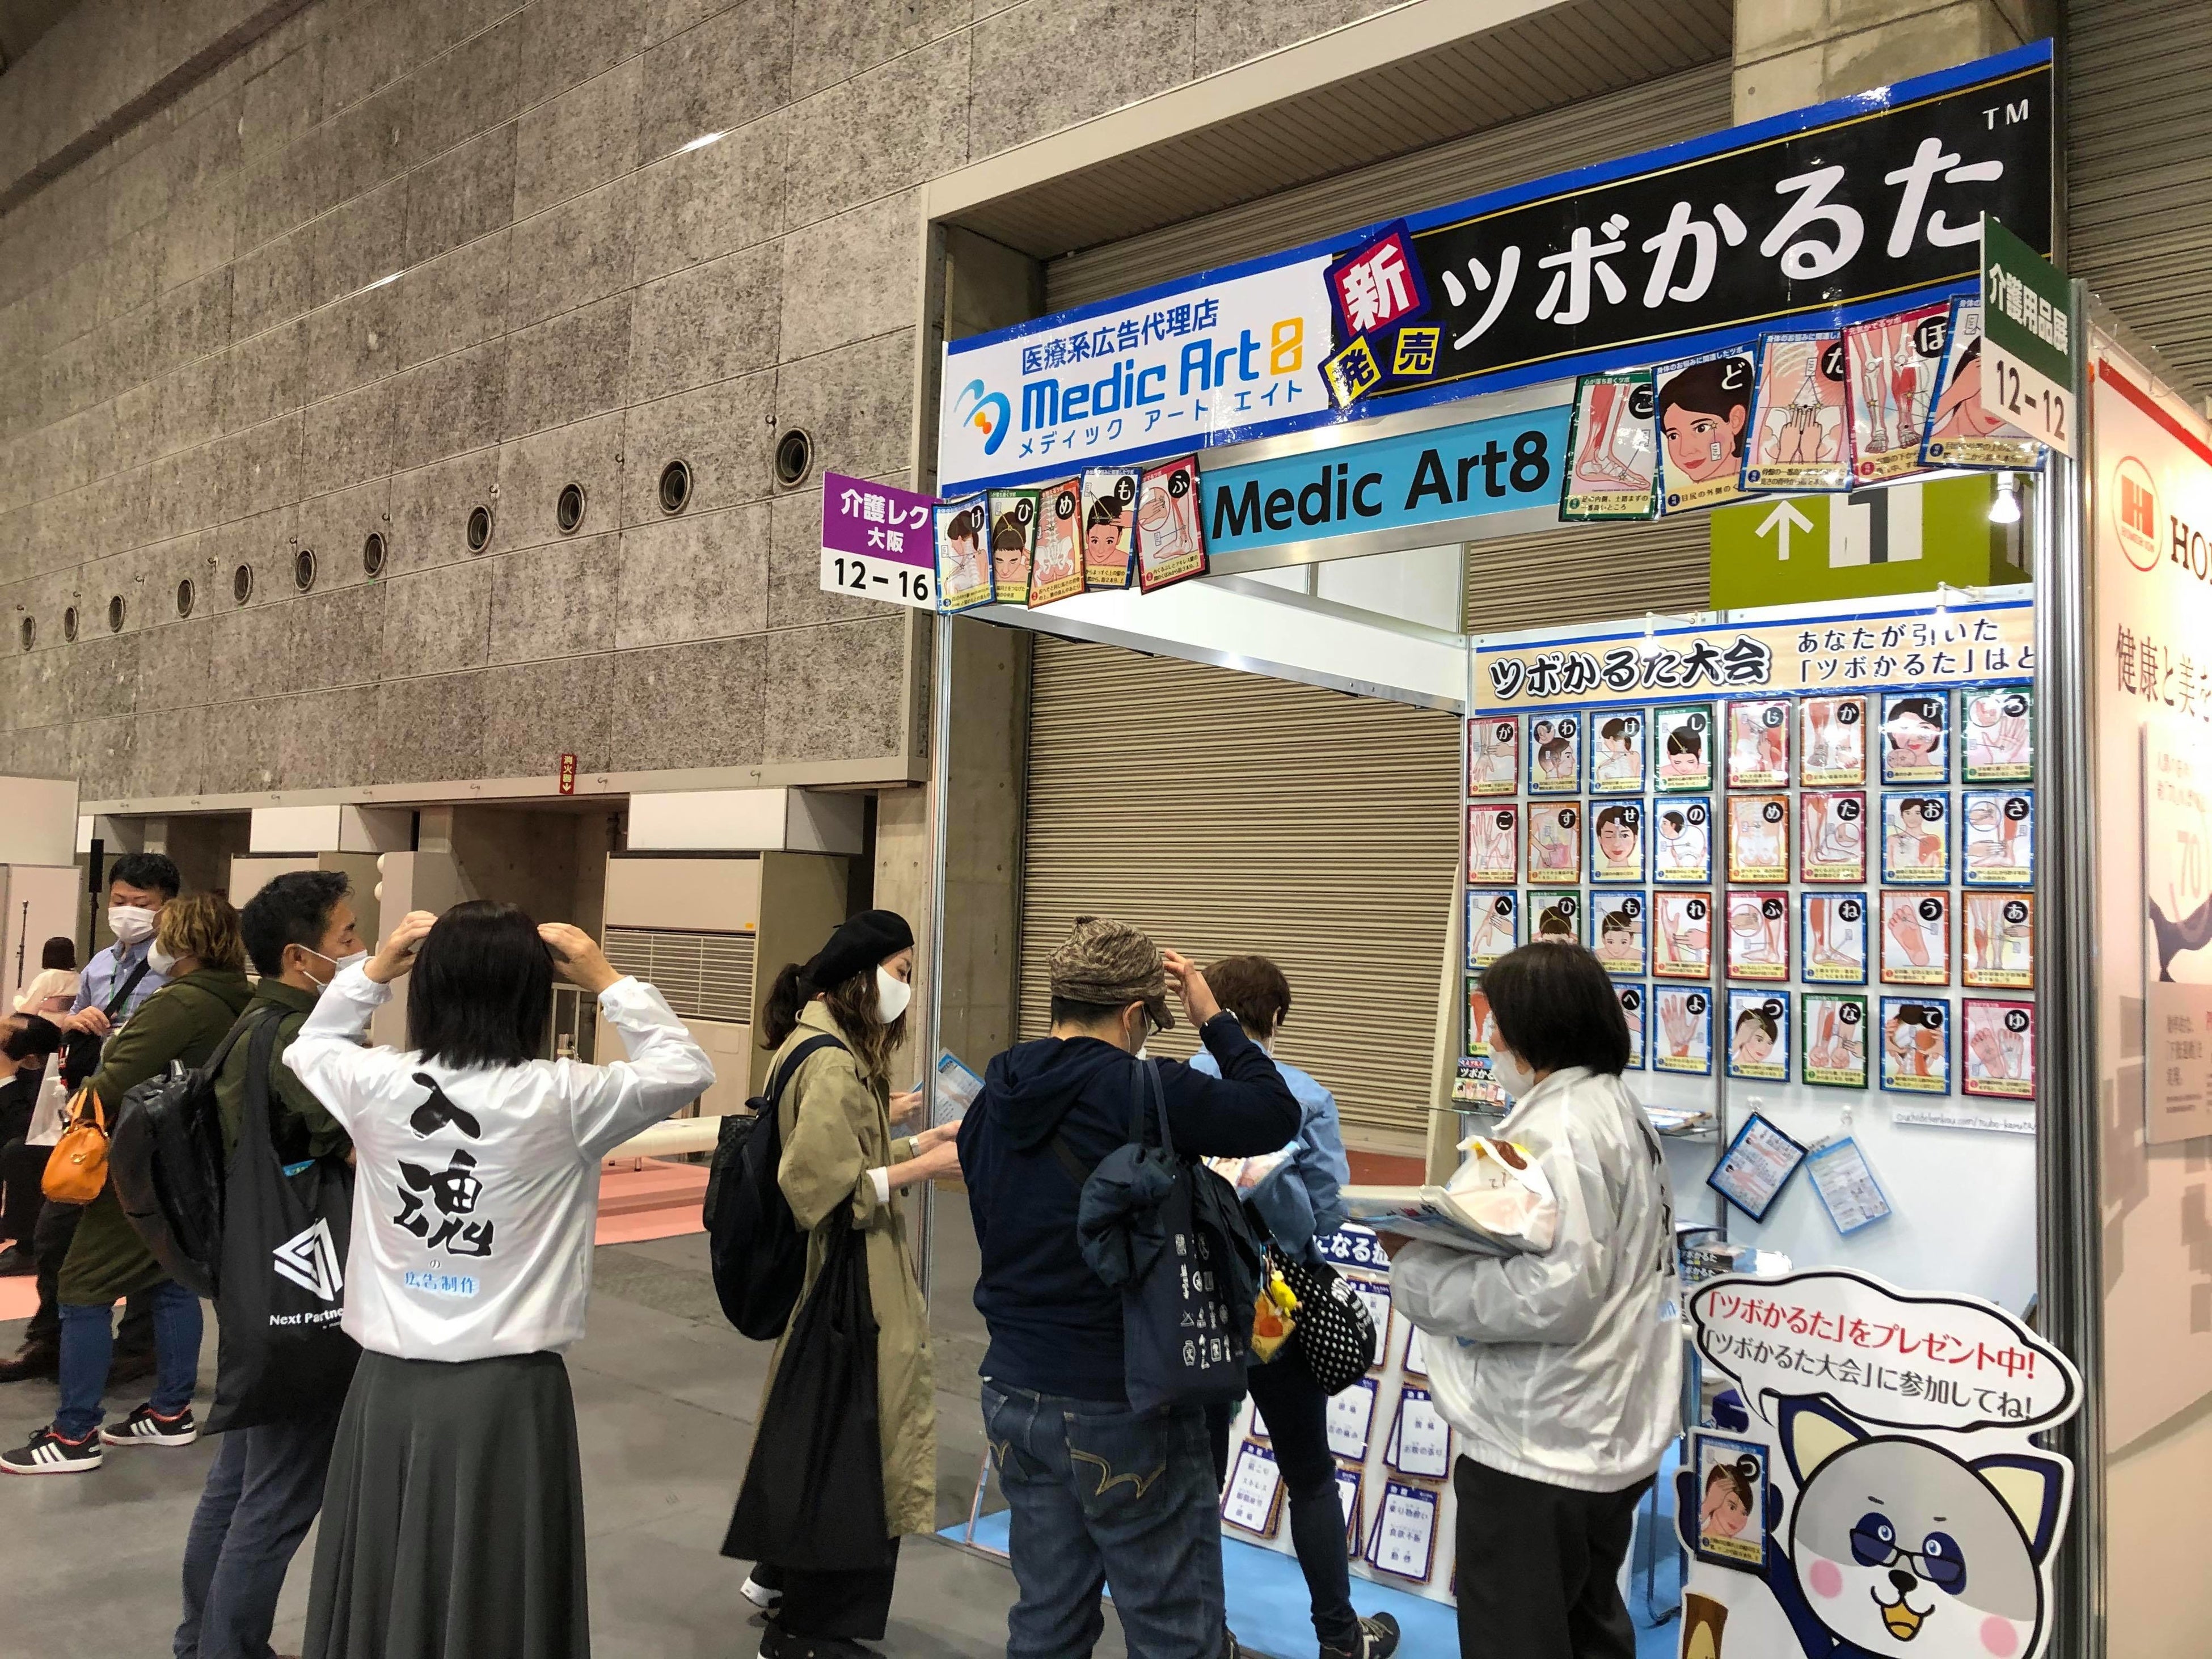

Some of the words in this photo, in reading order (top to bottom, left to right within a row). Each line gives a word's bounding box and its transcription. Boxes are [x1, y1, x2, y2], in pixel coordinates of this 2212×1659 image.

[1983, 98, 2029, 131] TM
[1442, 136, 2004, 351] ツボかるた
[1343, 244, 1409, 331] 新
[1989, 262, 2069, 356] 介護用品展
[1021, 298, 1219, 377] 医療系広告代理店
[1721, 361, 1746, 390] ど
[1996, 360, 2066, 442] 12-12
[1118, 480, 1131, 501] も
[1172, 476, 1187, 493] ふ
[1211, 462, 1383, 539] Medic
[1404, 430, 1550, 511] Art8
[840, 488, 929, 530] 介護レク
[1019, 504, 1031, 522] ひ
[1059, 496, 1072, 515] め
[972, 509, 982, 527] け
[868, 529, 904, 553] 大阪
[2170, 515, 2212, 585] HO
[1798, 618, 1998, 653] あなたが引いた
[1489, 635, 1771, 697] ツボかるた大会
[1801, 646, 2034, 683] 「ツボかるた」はと
[1842, 706, 1855, 719] か
[1923, 702, 1940, 717] げ
[1691, 718, 1702, 730] し
[1767, 711, 1779, 724] じ
[1562, 723, 1573, 734] わ
[1624, 721, 1636, 734] け
[563, 755, 573, 783] 消火器
[1623, 809, 1636, 822] せ
[1691, 810, 1702, 821] の
[1767, 806, 1779, 818] め
[1841, 802, 1856, 816] た
[1924, 803, 1939, 818] お
[2009, 801, 2023, 816] さ
[1561, 812, 1573, 826] す
[1561, 901, 1574, 914] ひ
[1626, 902, 1638, 915] も
[1690, 902, 1704, 916] れ
[1766, 902, 1780, 916] ふ
[1842, 904, 1858, 918] ね
[1924, 901, 1937, 917] う
[2008, 904, 2024, 919] あ
[1690, 998, 1703, 1012] よ
[1766, 1004, 1780, 1015] つ
[1843, 1007, 1858, 1021] な
[1923, 1010, 1939, 1025] て
[429, 1259, 441, 1269] の
[405, 1272, 475, 1295] 広告制作
[269, 1313, 302, 1326] Next
